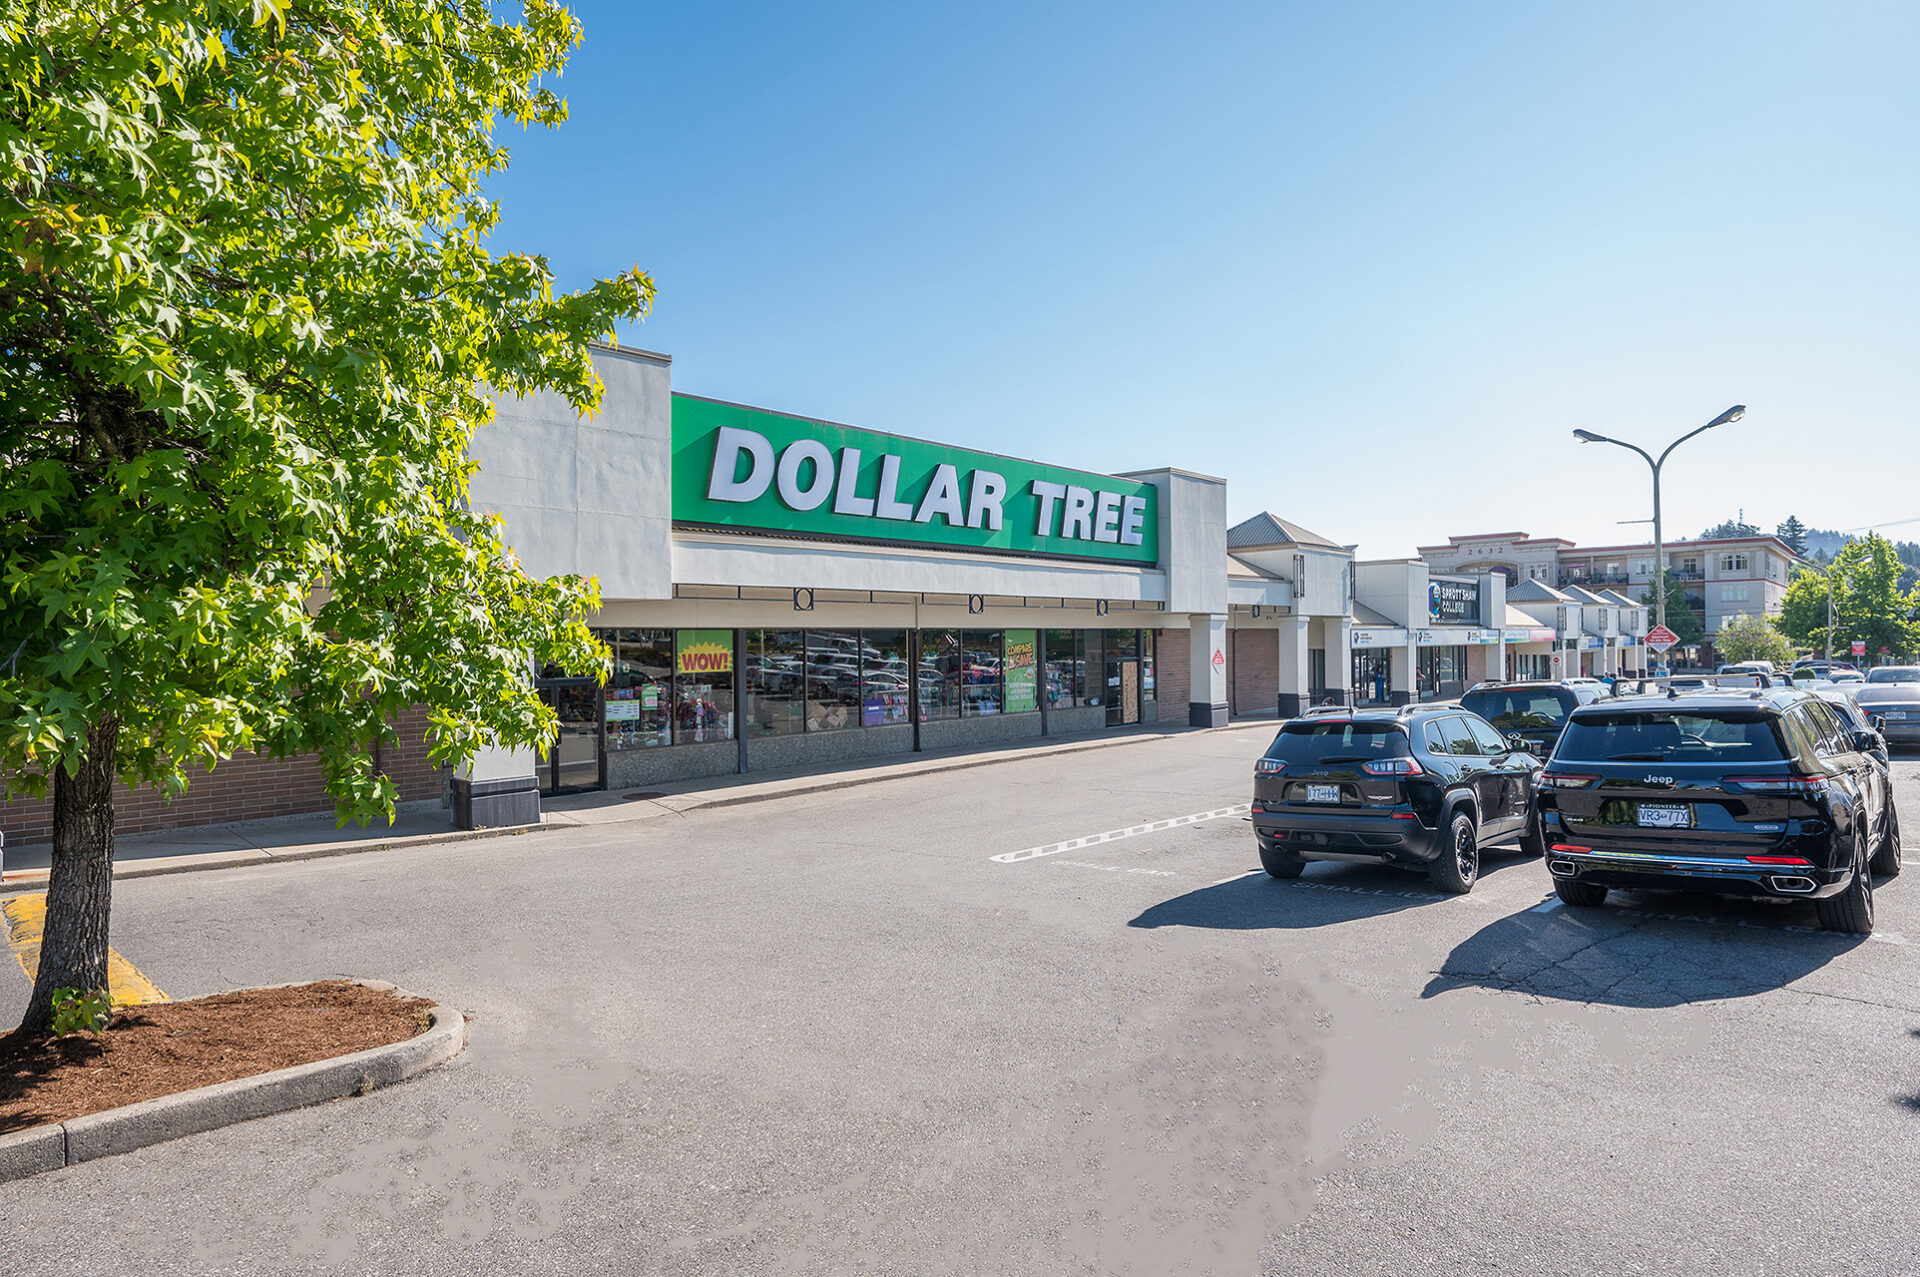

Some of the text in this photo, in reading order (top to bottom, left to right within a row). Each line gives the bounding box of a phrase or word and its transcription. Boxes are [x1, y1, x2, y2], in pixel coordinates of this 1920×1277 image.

[707, 425, 1146, 545] DOLLAR TREE
[1467, 547, 1503, 555] 2632
[1441, 587, 1477, 600] SPROTT SHAW
[1442, 600, 1464, 613] COLLEGE
[1007, 642, 1033, 656] COMPARE
[681, 653, 728, 670] WOW!
[1015, 652, 1034, 669] SAVE
[1643, 774, 1673, 784] Jeep
[1291, 882, 1390, 897] SMALL
